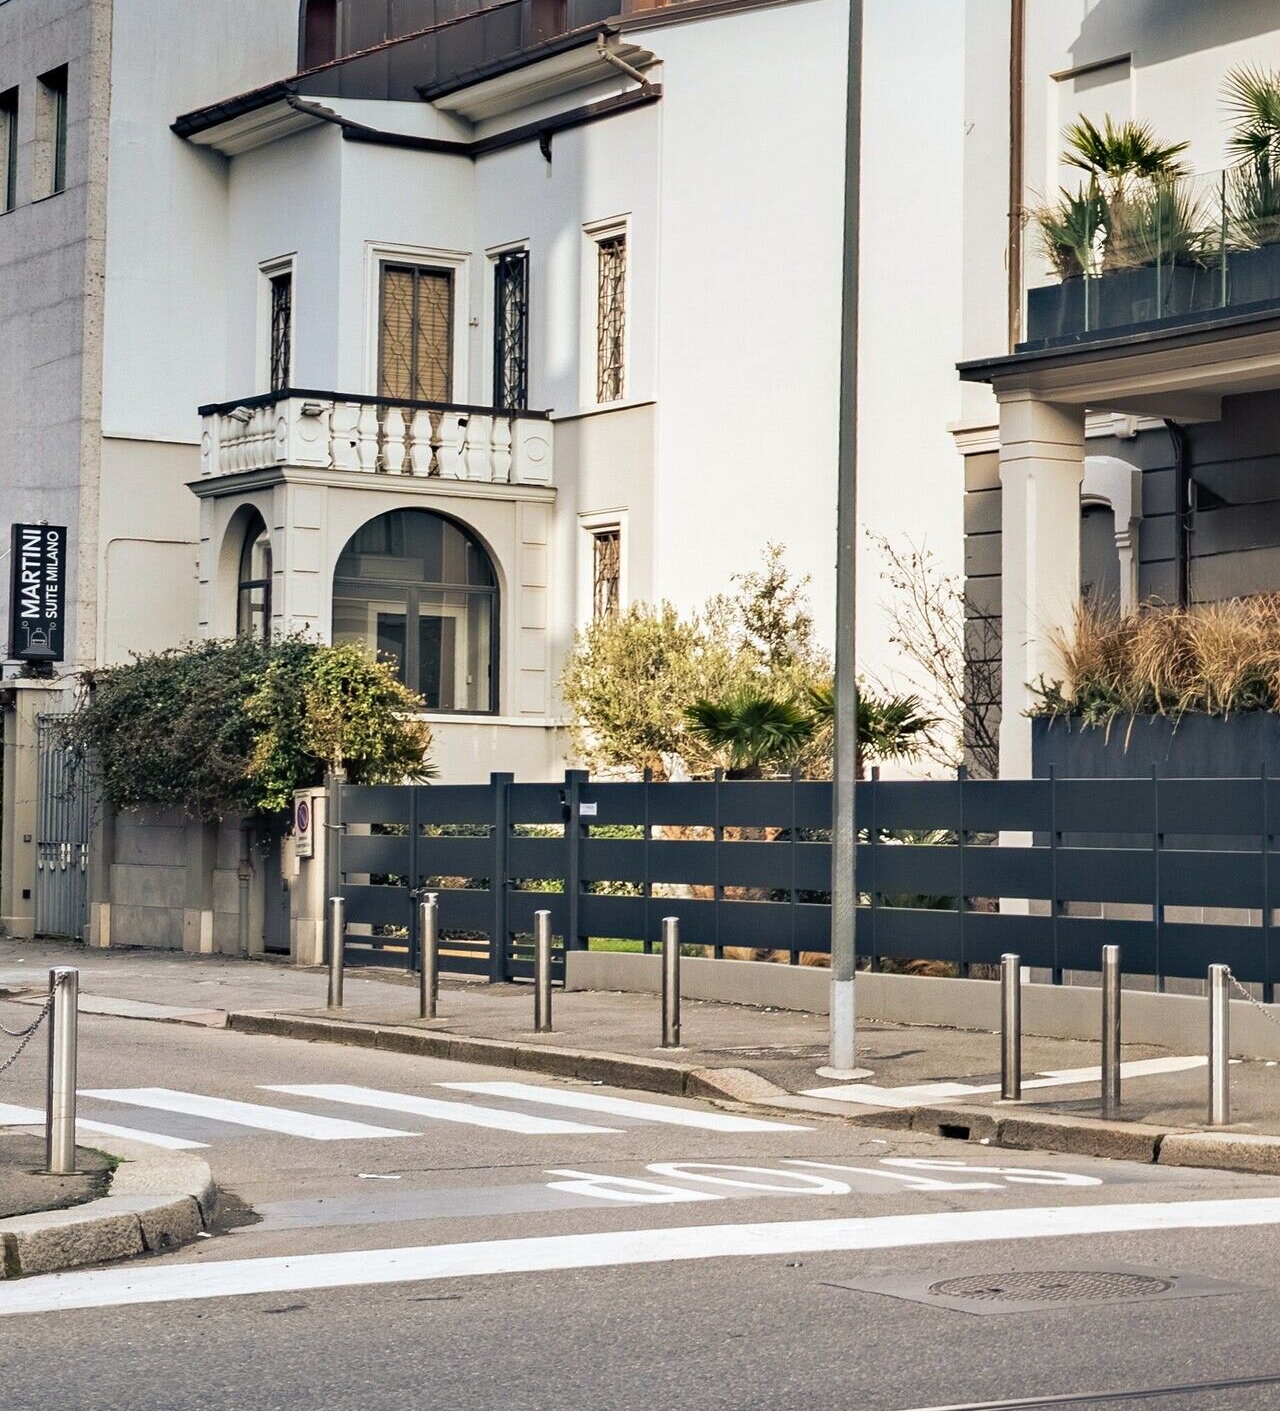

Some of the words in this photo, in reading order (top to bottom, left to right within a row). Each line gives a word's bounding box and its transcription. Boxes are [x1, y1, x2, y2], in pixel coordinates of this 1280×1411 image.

[21, 529, 42, 619] MARTINI
[46, 530, 59, 582] MILANO
[45, 584, 58, 619] SUITE
[543, 1157, 1103, 1204] STOP
